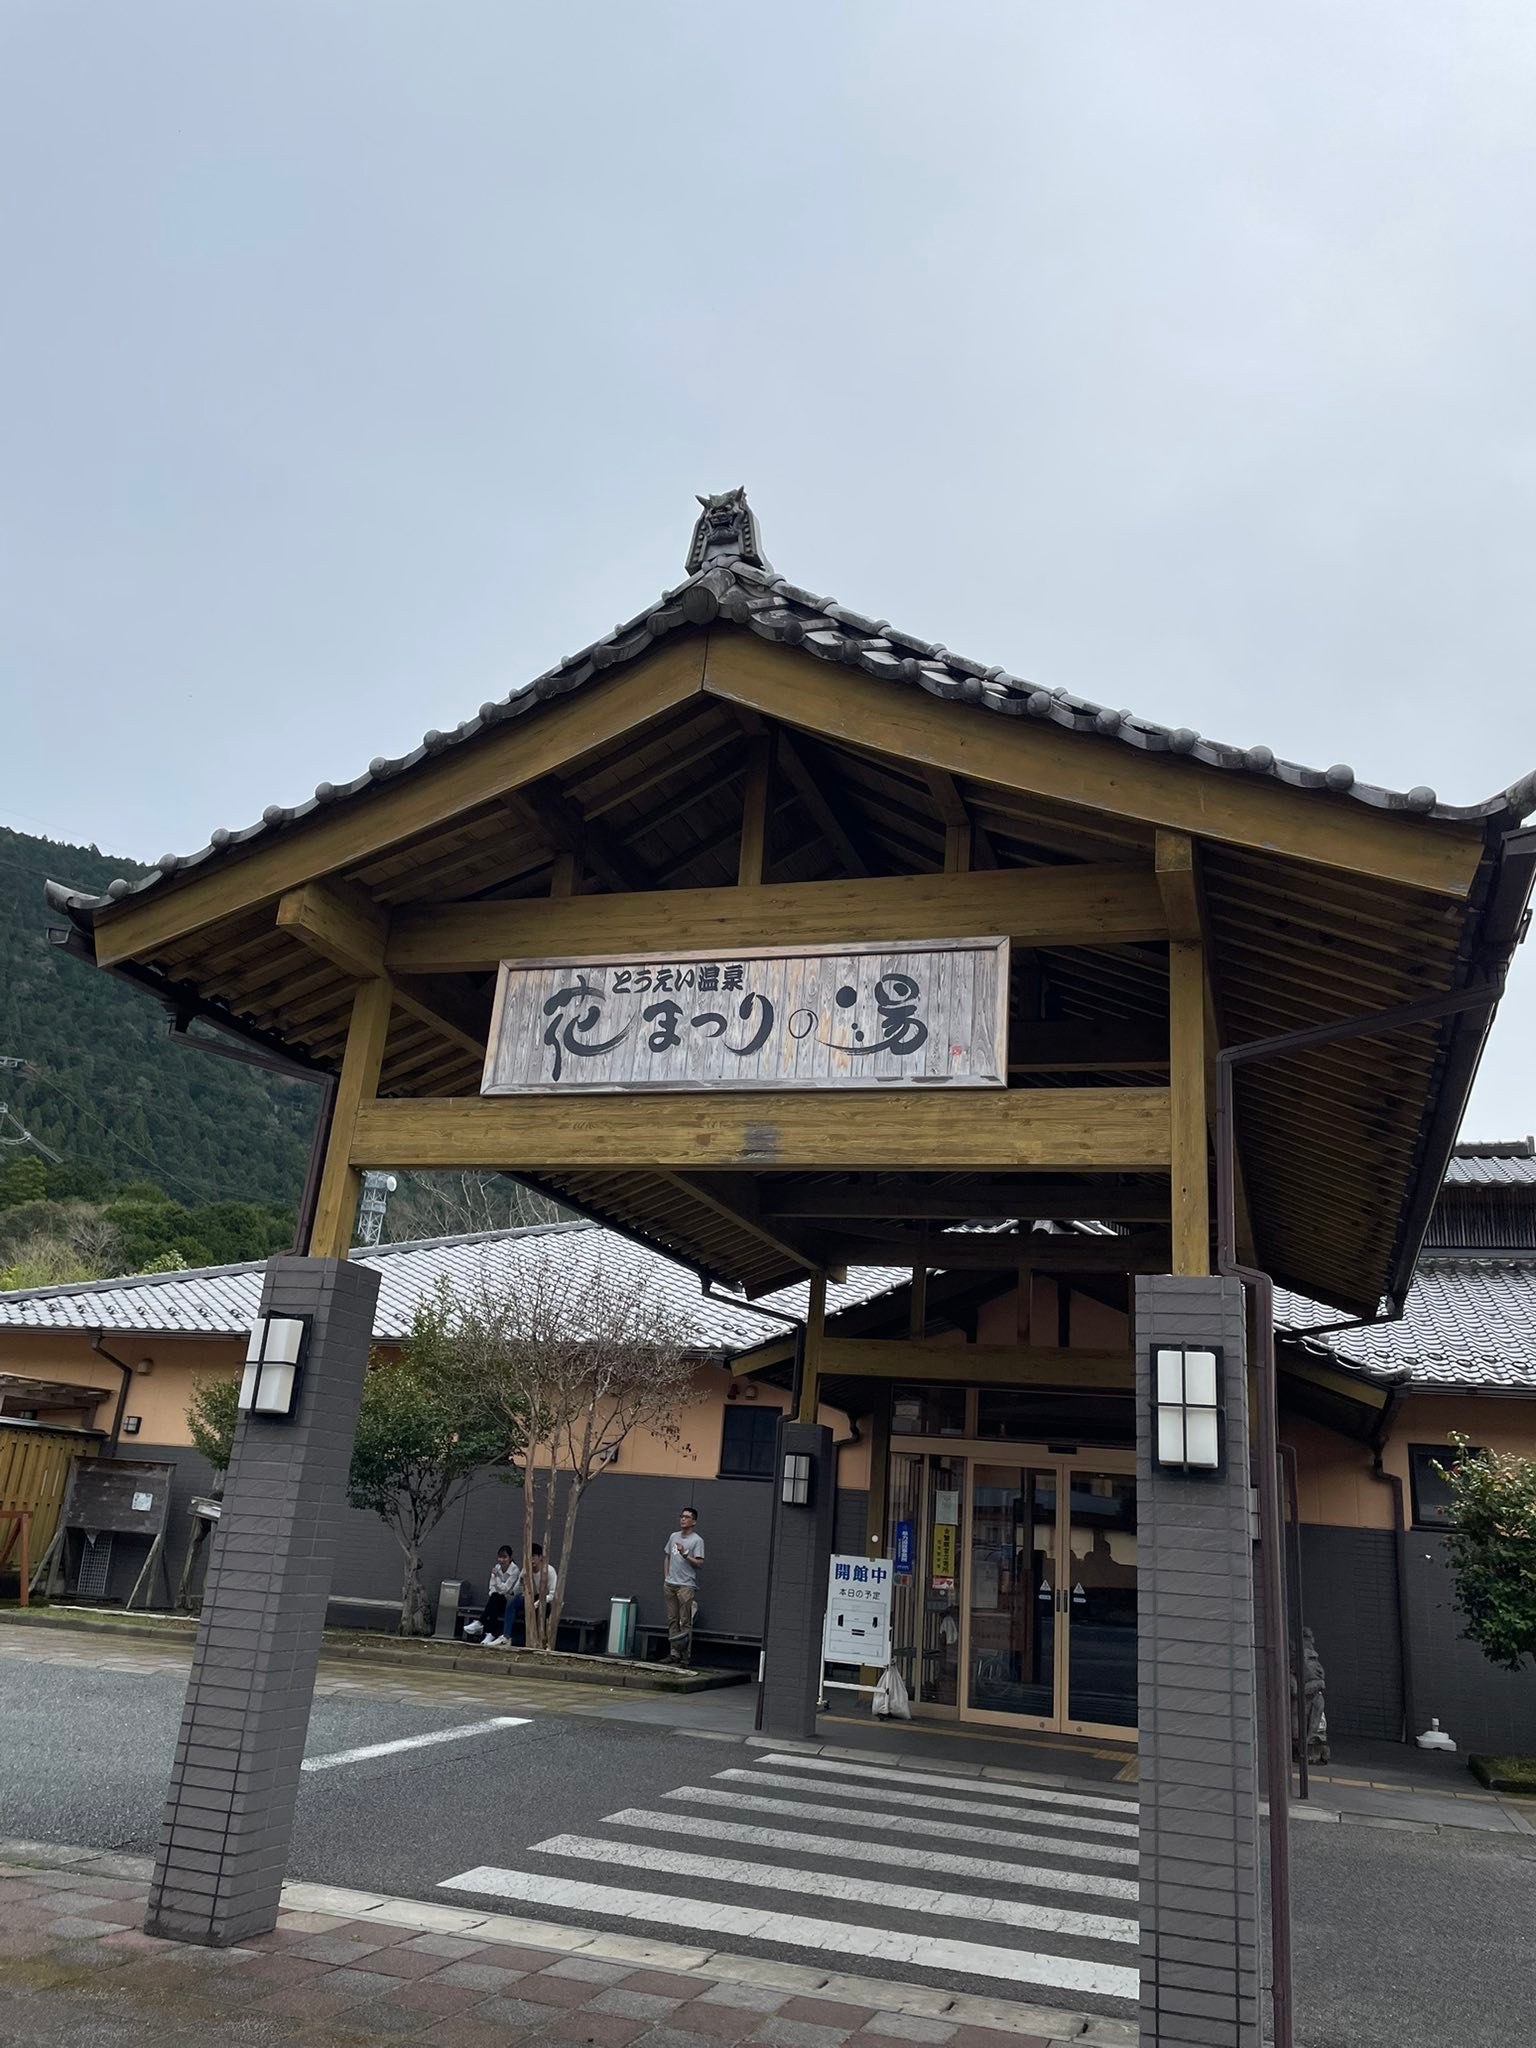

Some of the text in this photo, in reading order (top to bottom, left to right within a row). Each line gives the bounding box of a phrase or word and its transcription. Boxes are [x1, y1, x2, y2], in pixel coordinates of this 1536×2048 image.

[612, 965, 744, 993] とうえい温泉
[544, 973, 928, 1081] 花まつりの湯
[835, 1563, 887, 1584] 開館中
[839, 1588, 881, 1601] 本日の予定
